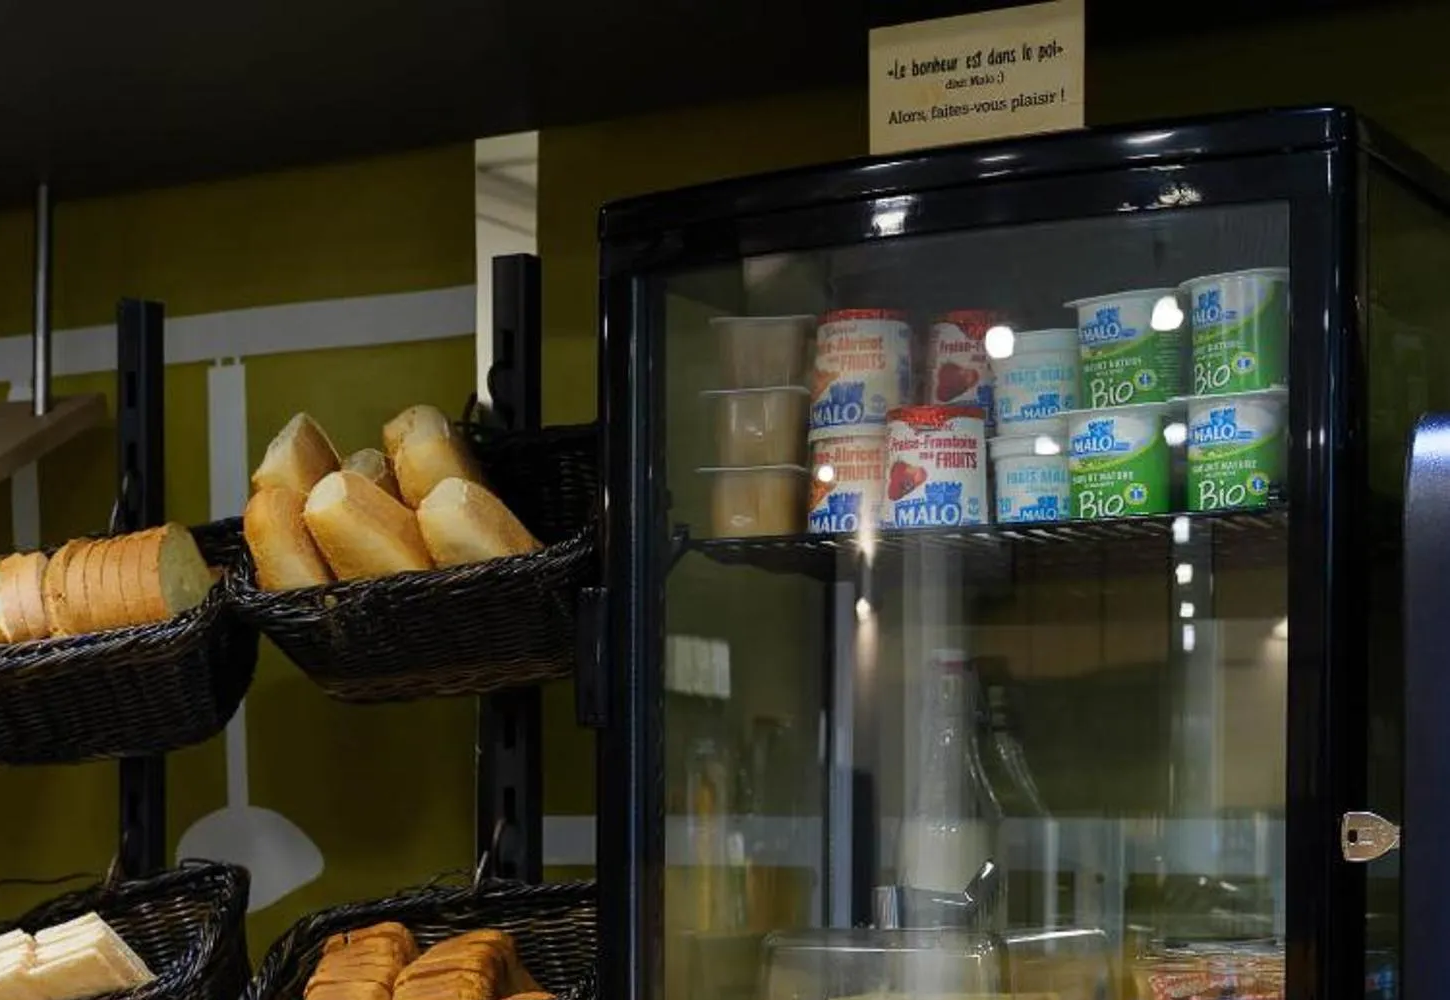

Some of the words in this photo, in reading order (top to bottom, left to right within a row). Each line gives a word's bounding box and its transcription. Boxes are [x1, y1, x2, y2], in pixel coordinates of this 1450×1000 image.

[912, 57, 958, 78] bonheur
[966, 51, 982, 70] est
[987, 48, 1016, 66] dans
[1022, 43, 1031, 62] le
[931, 99, 1007, 120] faites-vous
[1011, 91, 1057, 113] plaisir
[1194, 362, 1230, 396] Bio
[1091, 378, 1134, 410] Bio
[1074, 435, 1112, 454] MALO
[936, 451, 978, 470] FRUITS
[1078, 490, 1125, 519] Bio
[1198, 480, 1246, 512] Bio
[897, 503, 960, 526] MALO
